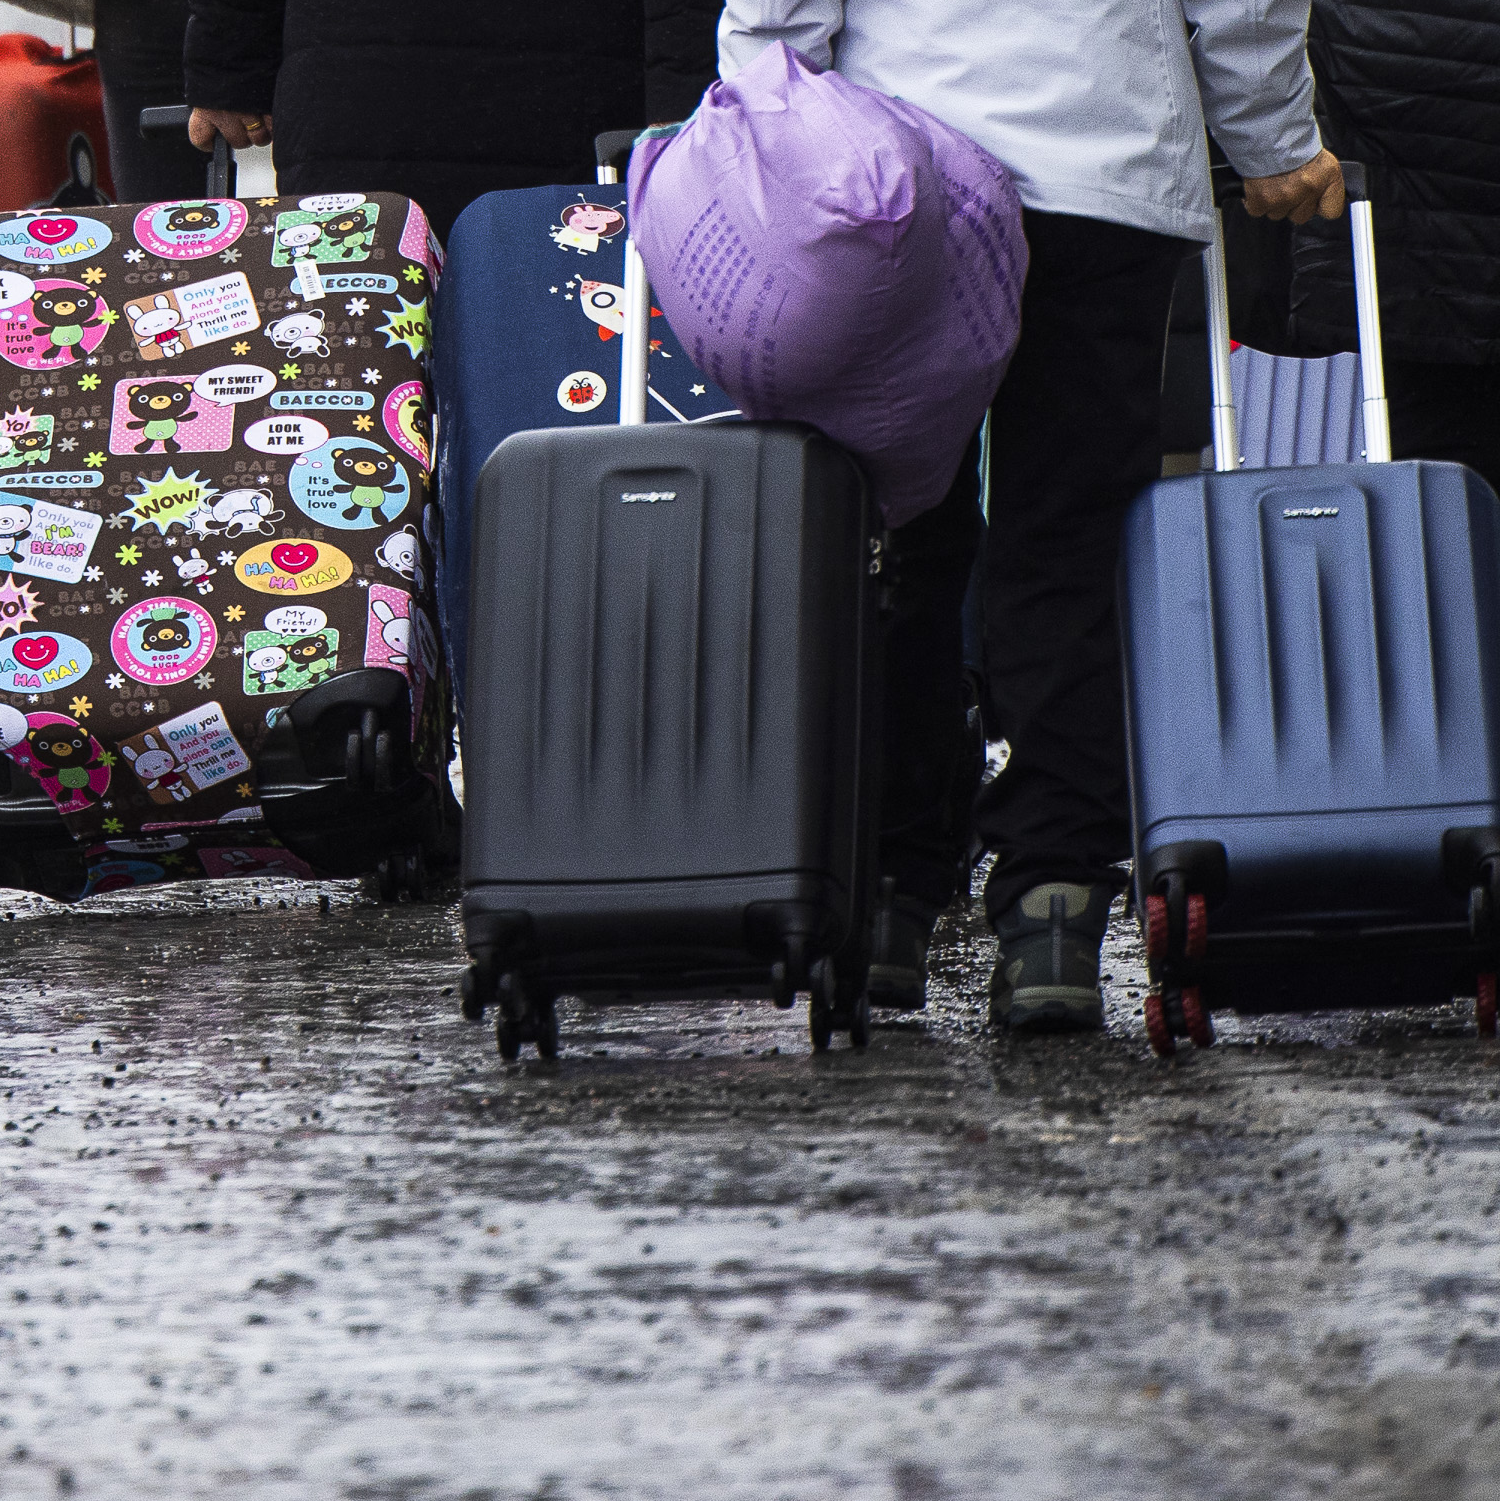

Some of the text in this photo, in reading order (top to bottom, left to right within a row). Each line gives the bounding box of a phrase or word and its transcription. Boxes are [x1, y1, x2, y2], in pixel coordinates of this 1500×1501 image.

[24, 247, 55, 260] HA
[57, 237, 98, 257] HA!
[178, 245, 213, 257] ONLY
[137, 259, 181, 271] BAE
[183, 280, 241, 302] Only you
[190, 292, 238, 311] And you
[189, 297, 249, 322] alone can
[6, 321, 27, 331] It's
[197, 309, 248, 329] Thrill me
[5, 333, 33, 343] true
[204, 325, 229, 338] like
[6, 344, 35, 355] love
[303, 363, 345, 376] BAE
[19, 372, 61, 387] BAE
[208, 375, 264, 386] MY SWEET
[279, 394, 365, 406] BAECCOB
[60, 405, 103, 419] BAE
[268, 423, 302, 434] LOOK
[266, 435, 305, 445] AT ME
[234, 459, 278, 474] BAE
[5, 474, 94, 485] BAECCOB
[308, 475, 330, 485] It's
[306, 487, 335, 498] true
[133, 487, 201, 520] WOW!
[307, 499, 338, 510] love
[37, 508, 71, 525] Only
[72, 518, 95, 530] you
[44, 523, 76, 542] I'M
[30, 540, 86, 558] BEAR!
[28, 555, 55, 571] like
[244, 561, 275, 577] HA
[268, 575, 299, 591] HA
[300, 566, 340, 589] HA!
[58, 589, 96, 602] BAE
[285, 609, 308, 620] MY
[117, 607, 145, 640] HAPPY
[190, 609, 212, 634] LOVE
[276, 618, 318, 627] Friend!
[151, 653, 181, 662] GOOD
[153, 661, 179, 670] LUCK
[13, 673, 42, 688] HA
[42, 659, 81, 684] HA!
[155, 667, 188, 682] ONLY
[119, 684, 160, 700] BAE
[169, 713, 220, 742] Only you
[179, 729, 221, 752] And you
[182, 747, 210, 764] alone
[210, 735, 234, 750] can
[191, 748, 237, 772] Thrill me
[202, 764, 227, 781] like
